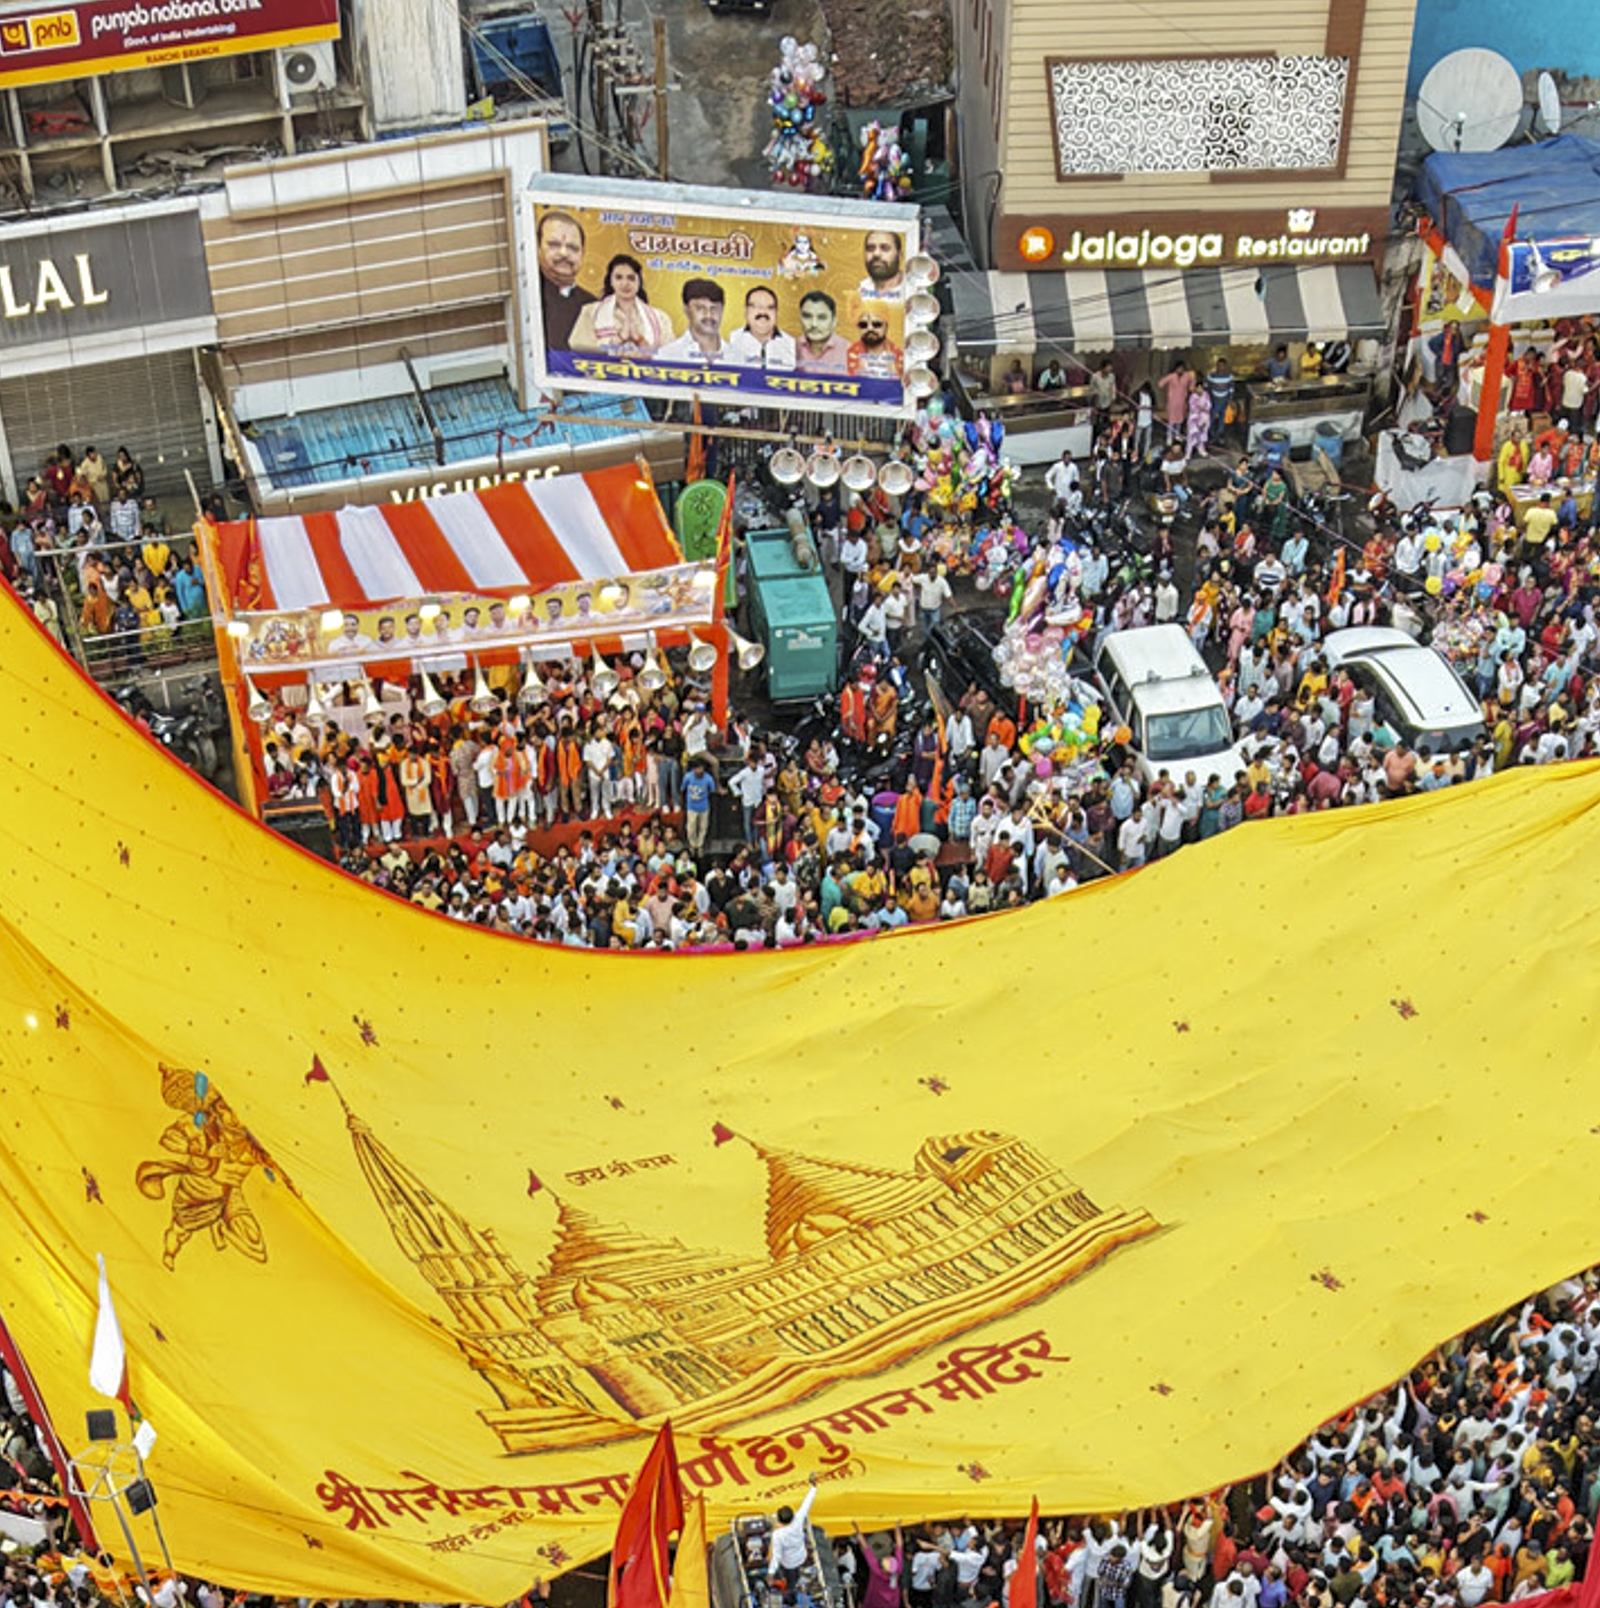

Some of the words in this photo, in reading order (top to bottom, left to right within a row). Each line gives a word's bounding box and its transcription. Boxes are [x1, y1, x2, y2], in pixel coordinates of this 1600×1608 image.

[35, 21, 73, 46] pnb
[91, 9, 149, 38] punjab
[150, 0, 219, 25] national
[160, 29, 182, 43] India
[628, 229, 754, 261] रामनवमी
[1062, 229, 1224, 267] Jalajoga
[1235, 233, 1371, 259] Restaurant
[572, 355, 742, 388] सुबोधकांत
[766, 371, 861, 397] सहाय
[564, 1165, 609, 1187] जय
[605, 1159, 637, 1179] श्री
[631, 1152, 679, 1170] राम
[315, 1469, 391, 1531] श्री
[737, 1387, 935, 1478] हनुमान
[919, 1329, 1071, 1402] मंदिर
